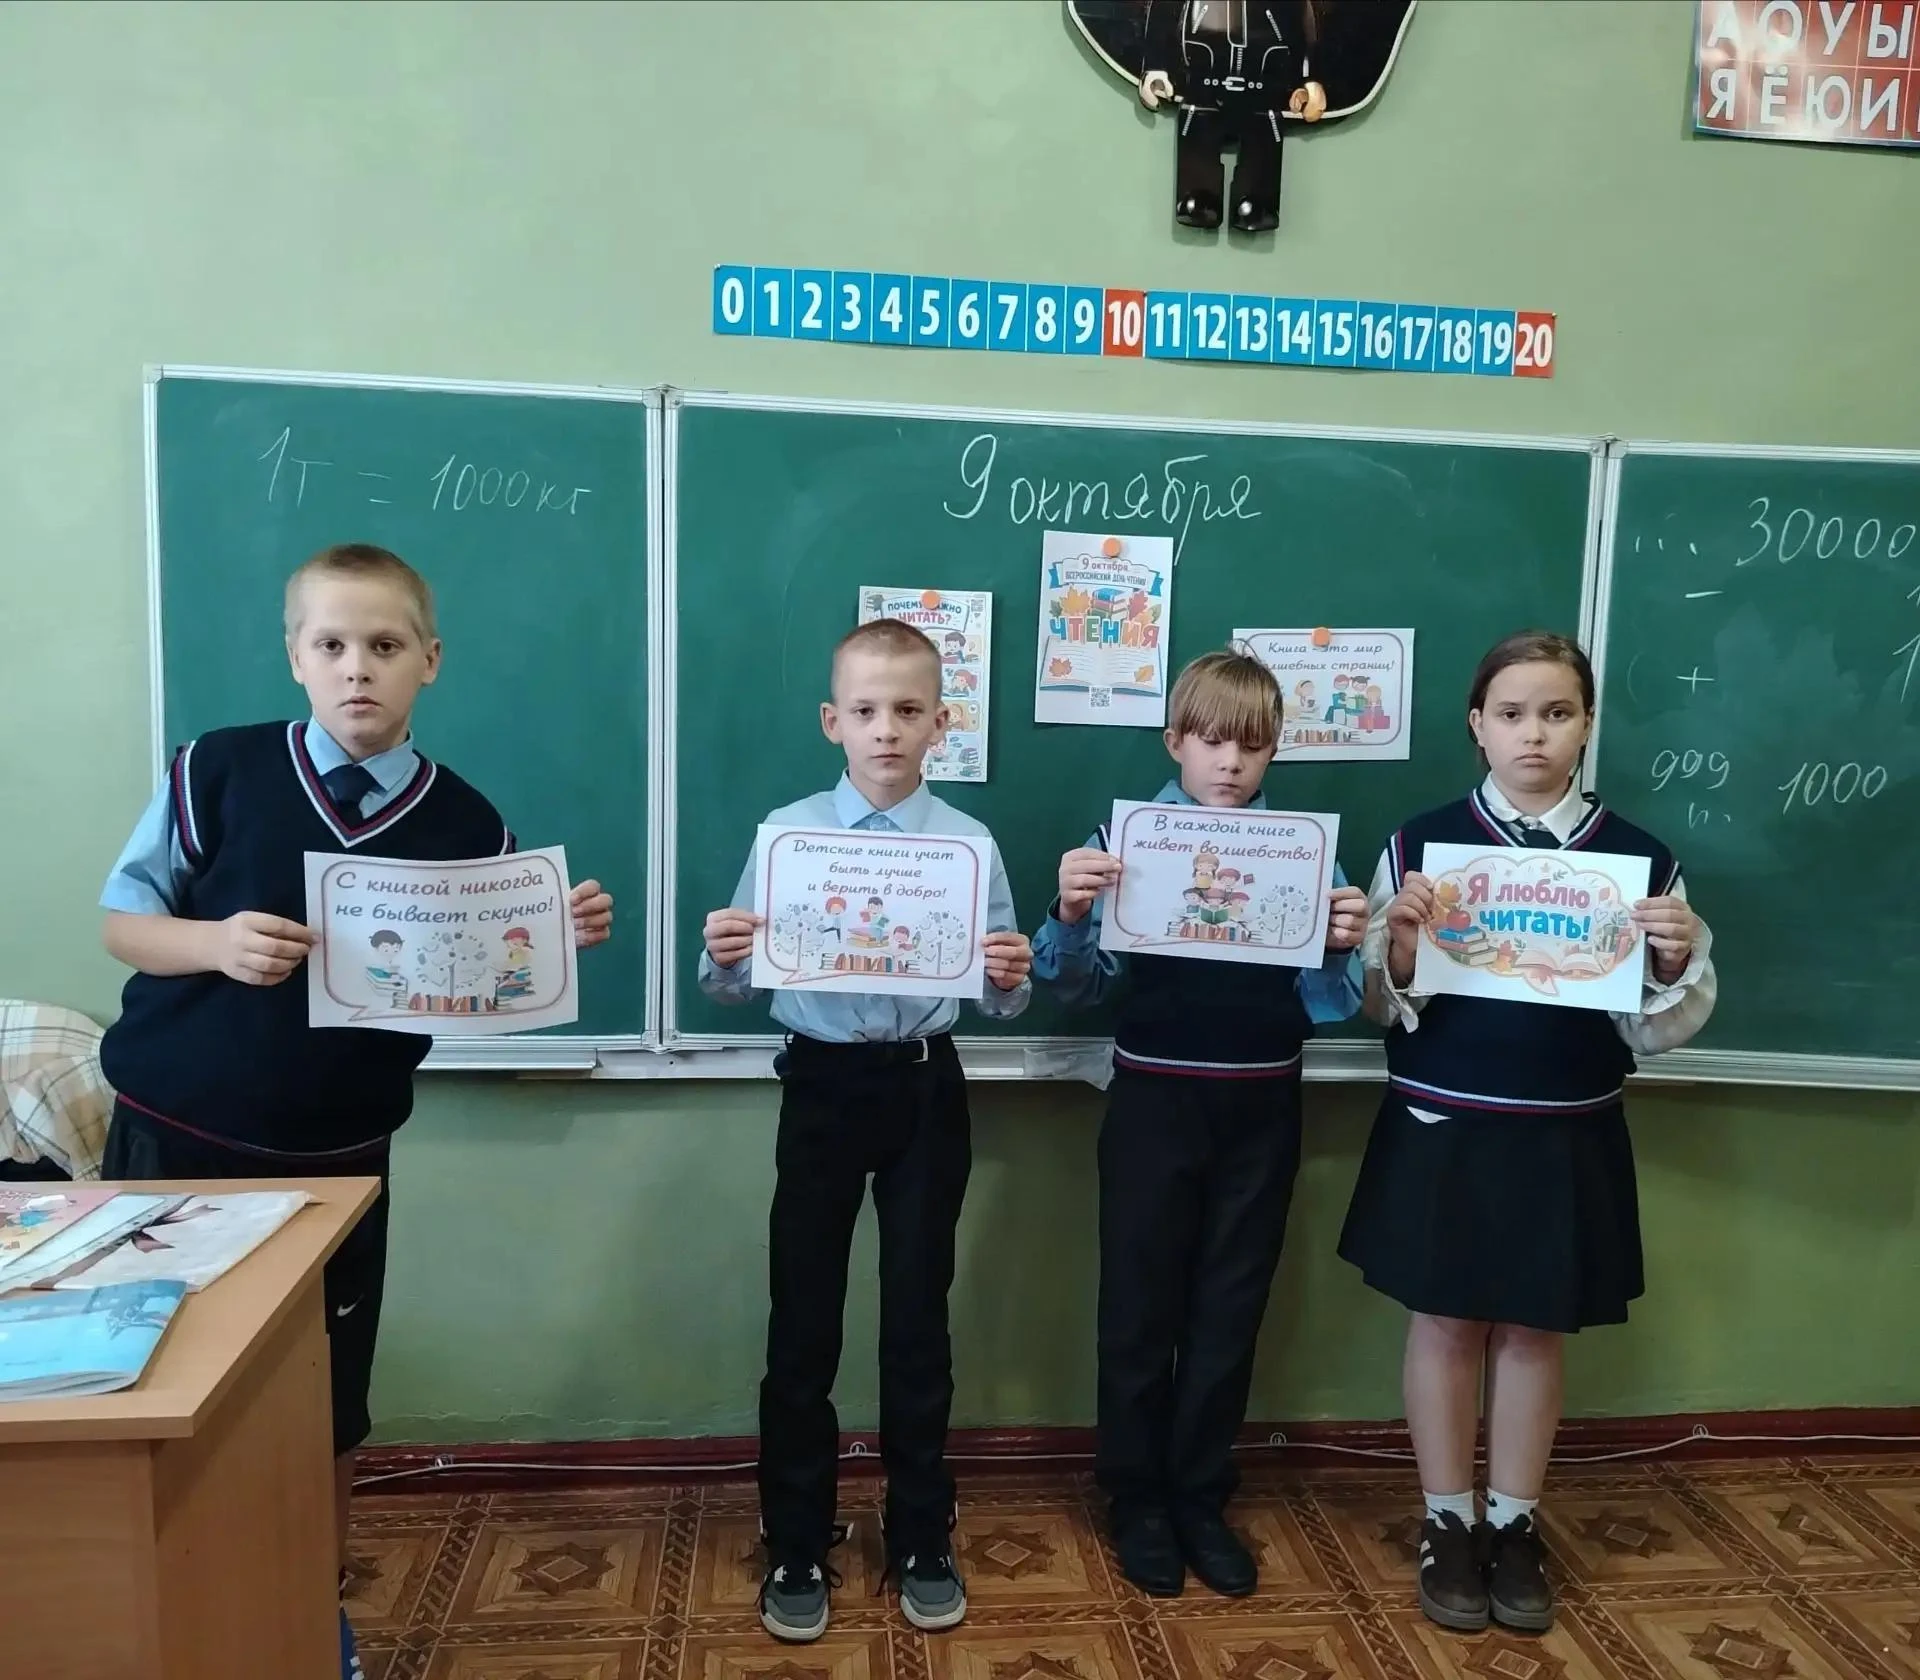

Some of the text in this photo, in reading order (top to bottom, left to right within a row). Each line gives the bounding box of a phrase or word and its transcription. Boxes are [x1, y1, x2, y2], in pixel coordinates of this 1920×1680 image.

[721, 278, 1553, 367] 0 1 2 3 4 5 6 7 8 9 10 11 12 13 14 15 16 17 18 19 20
[943, 433, 1262, 566] 9 октября
[1735, 496, 1917, 567] 30000
[1082, 558, 1129, 573] 9 октября
[898, 611, 951, 625] ЧИТАТЬ?
[1050, 616, 1159, 648] ЧТЕНИЯ
[1268, 642, 1307, 653] Книга
[1353, 645, 1383, 655] мир
[1265, 660, 1395, 672] лшебных страниц!
[1777, 761, 1887, 815] 1000
[1153, 814, 1296, 838] В каждой книге
[792, 839, 954, 862] Детские книги учат
[1132, 837, 1319, 862] живет волшебство!
[336, 869, 544, 896] С книгой никогда
[829, 861, 922, 880] быть лучше
[807, 879, 947, 900] и верить в добро!
[1467, 873, 1591, 909] Я люблю
[335, 896, 554, 924] не бывает скучно!
[1479, 909, 1592, 942] читать!
